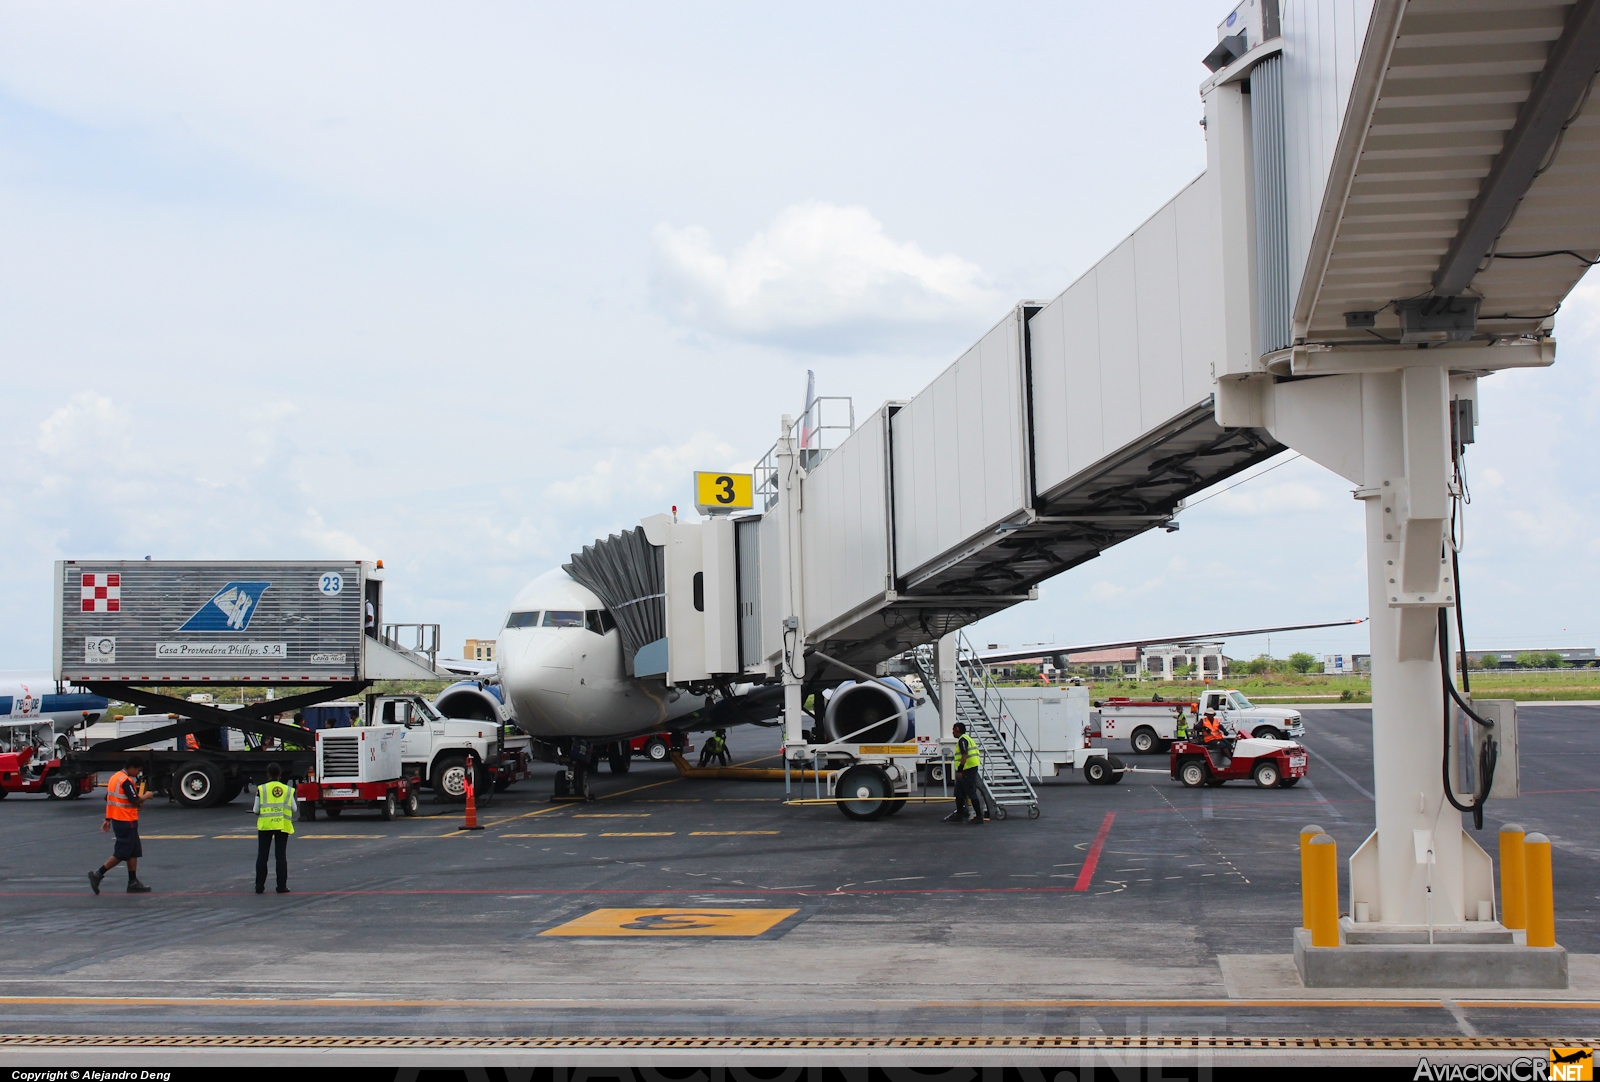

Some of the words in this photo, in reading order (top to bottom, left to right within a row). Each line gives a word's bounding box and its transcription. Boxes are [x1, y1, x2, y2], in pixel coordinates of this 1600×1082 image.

[715, 476, 736, 504] 3
[323, 576, 340, 592] 23
[158, 644, 178, 654] Casa
[180, 644, 226, 654] Proveedora
[227, 644, 261, 656] Phillips,
